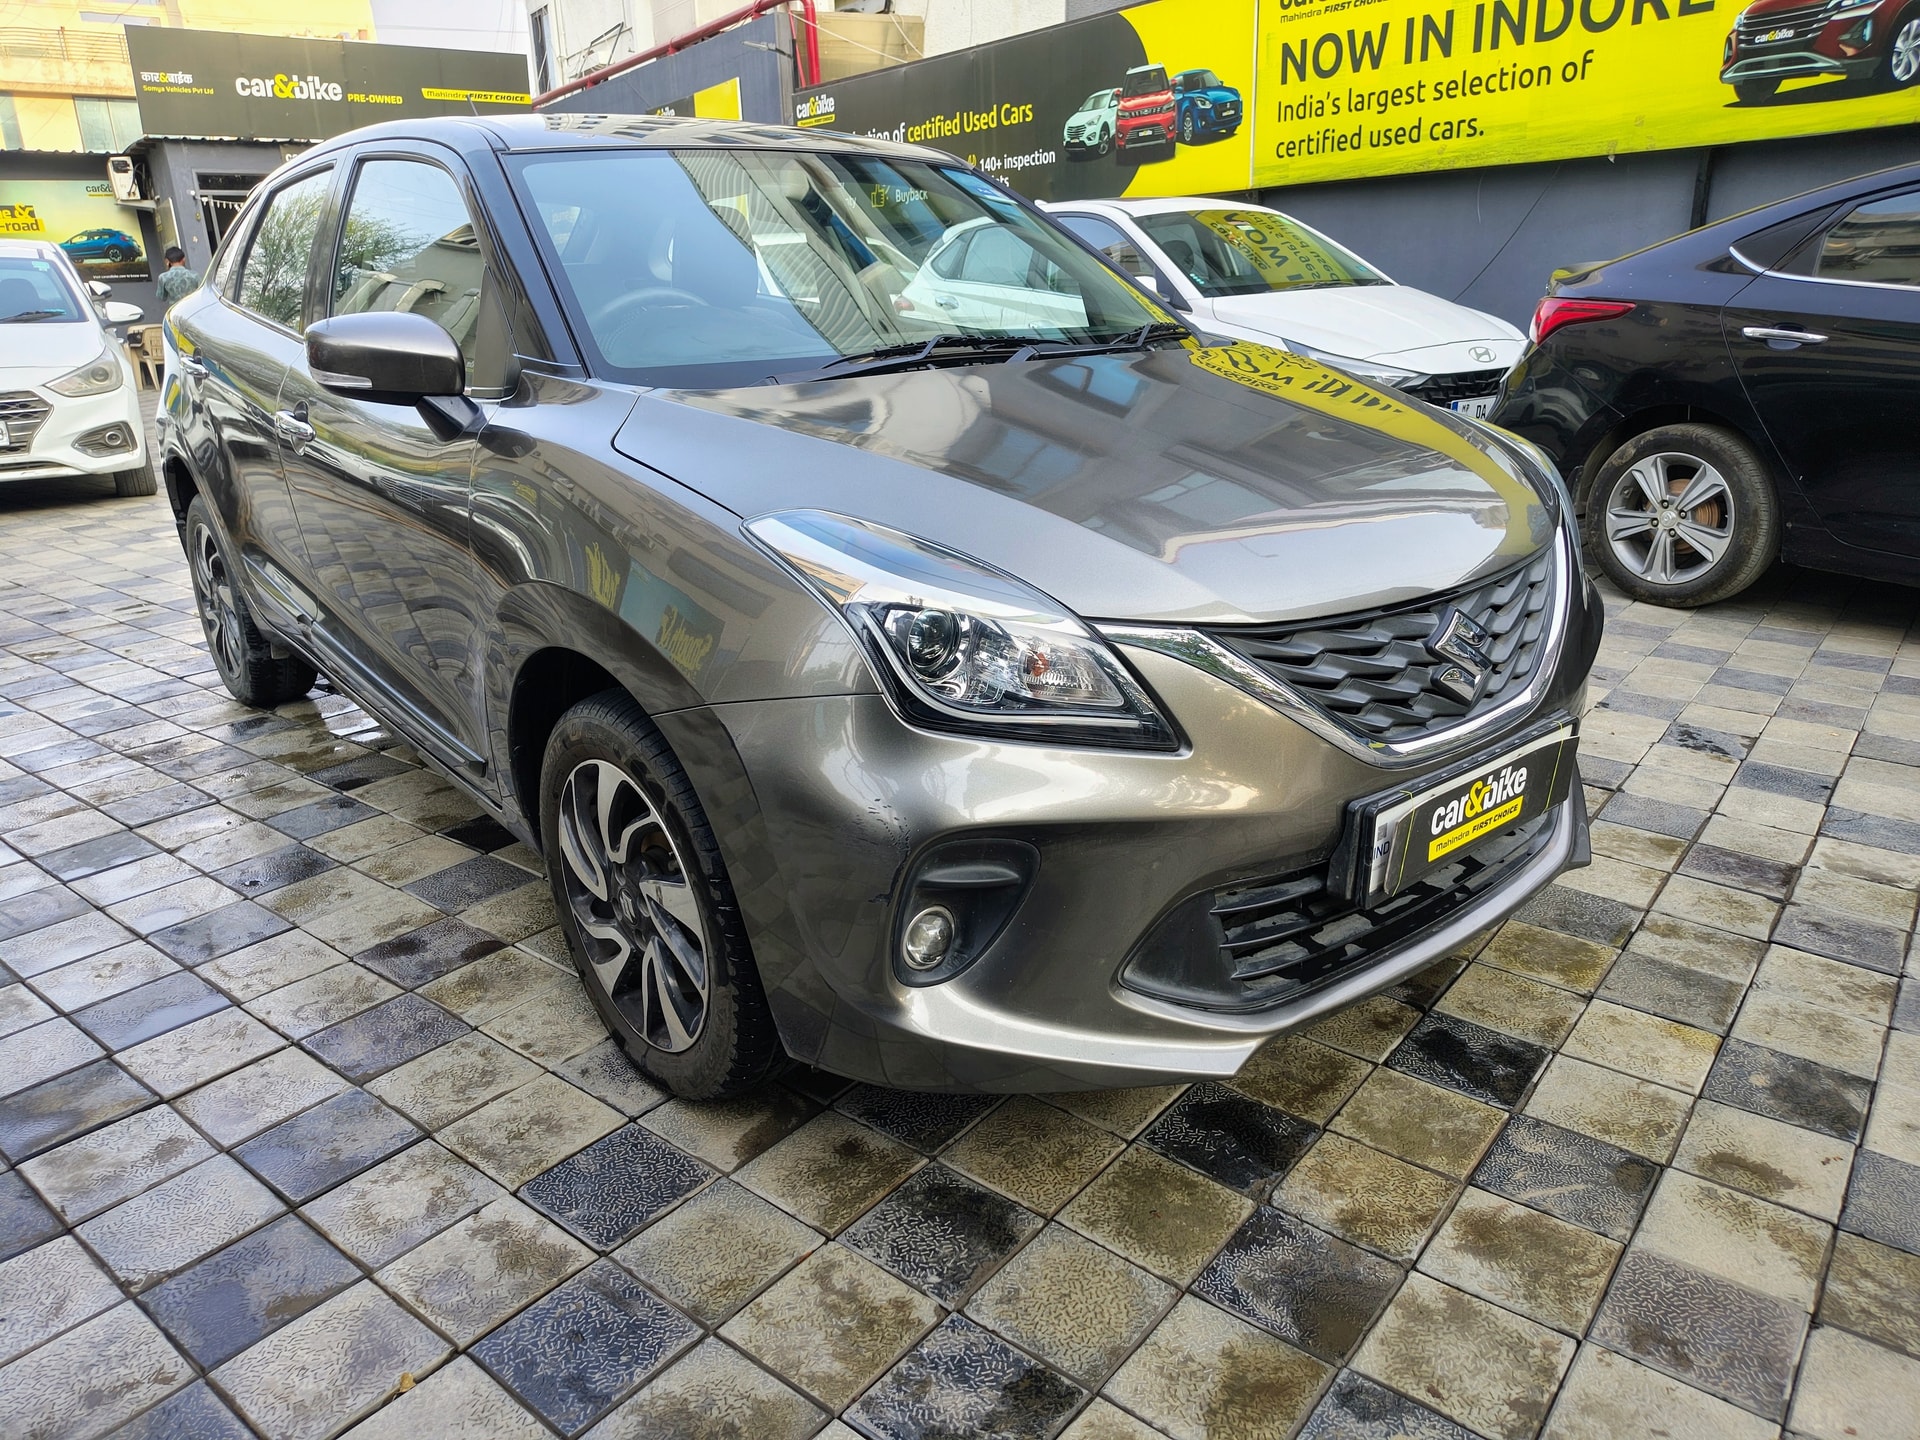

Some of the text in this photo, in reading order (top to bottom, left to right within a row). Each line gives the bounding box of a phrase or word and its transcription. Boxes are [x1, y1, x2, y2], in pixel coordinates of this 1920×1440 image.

[1280, 9, 1322, 23] Mahindra
[1324, 1, 1352, 14] FIRST
[1280, 0, 1716, 85] NOW IN INDO
[1754, 28, 1795, 44] car&bike
[166, 86, 192, 94] Vehicles
[192, 87, 203, 95] Pvt
[204, 87, 214, 95] Ltd
[235, 73, 403, 105] car&bike PRE-OWNED
[495, 94, 525, 102] CHOICE
[1278, 49, 1594, 123] India's largest selection of
[796, 93, 835, 119] car&bike
[907, 112, 960, 143] certified
[963, 104, 998, 133] Used
[1000, 103, 1033, 126] Cars
[1276, 117, 1484, 159] certified used cars.
[980, 148, 1056, 172] 140+ inspection
[1431, 766, 1528, 836] car&bike
[1435, 804, 1519, 852] Mahindra FIRST CHOICE
